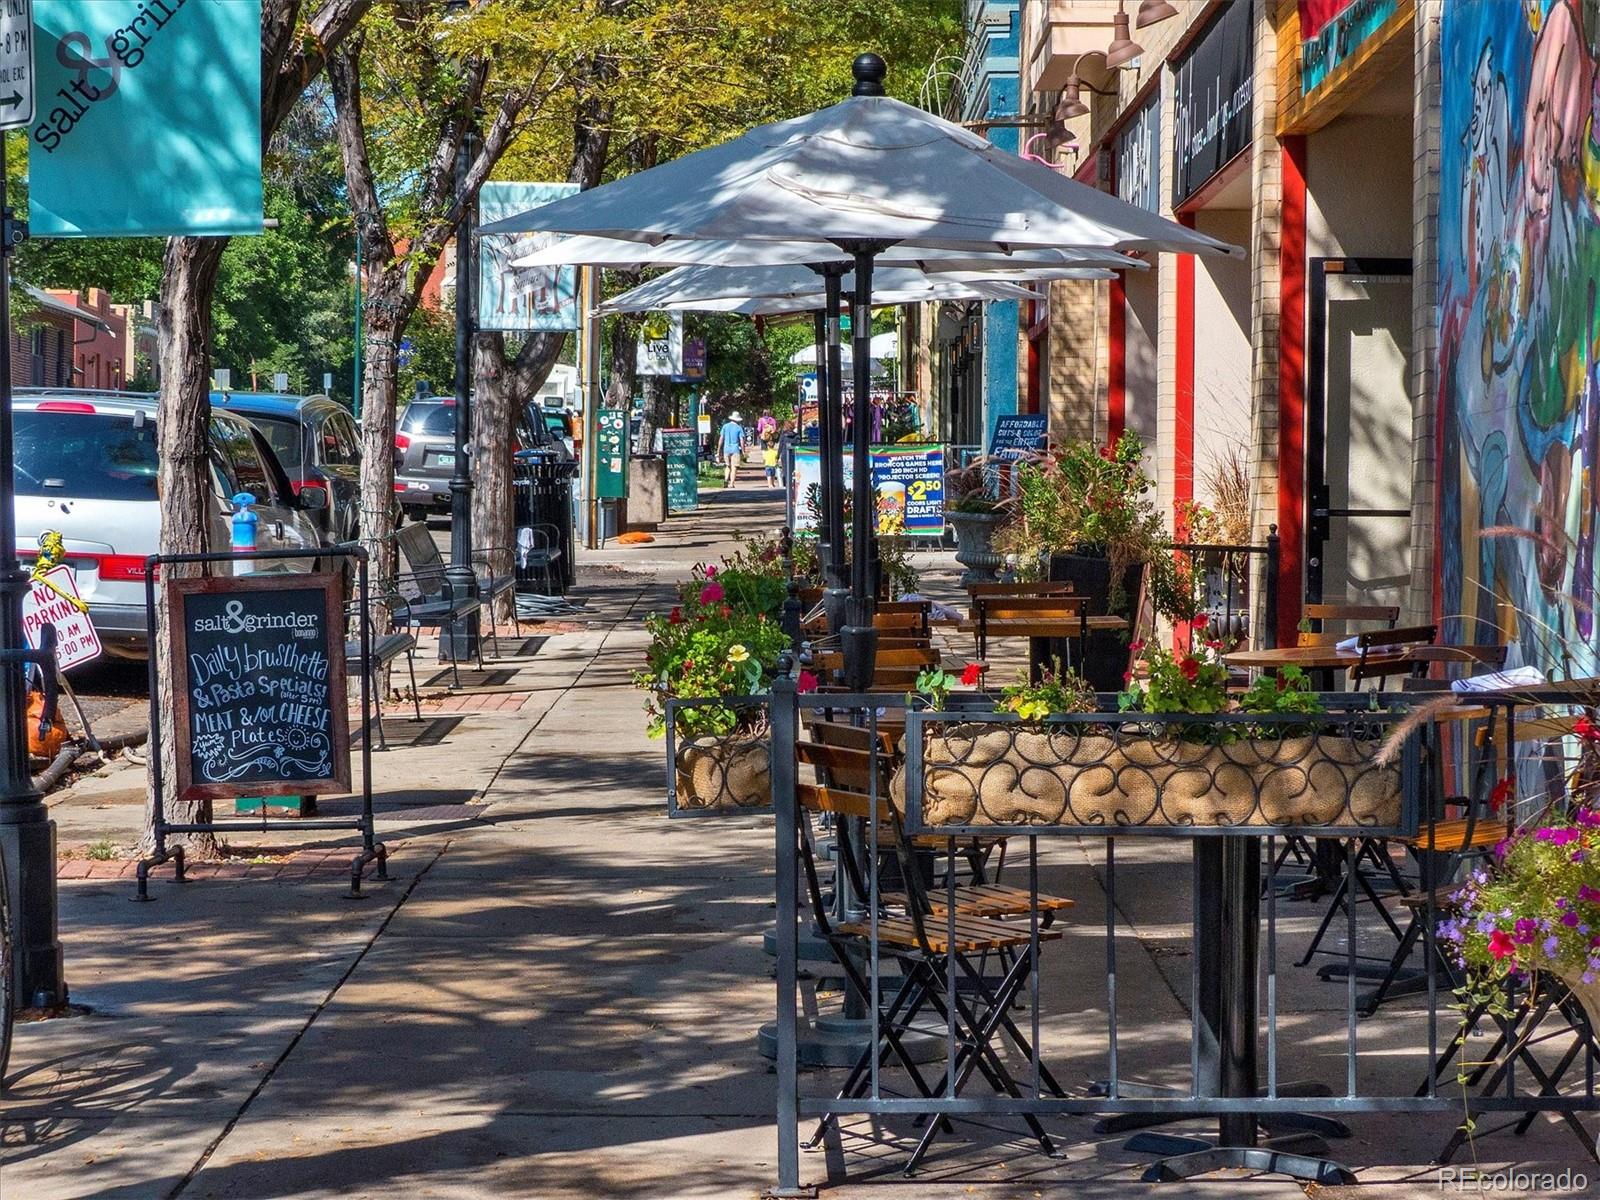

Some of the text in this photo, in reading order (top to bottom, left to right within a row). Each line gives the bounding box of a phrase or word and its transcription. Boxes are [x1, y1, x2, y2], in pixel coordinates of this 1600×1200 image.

[14, 30, 27, 52] PM
[13, 66, 25, 81] EXC
[647, 344, 670, 353] Live
[1000, 420, 1046, 428] AFFORDABLE
[890, 455, 914, 463] WATCH
[907, 505, 943, 515] DRAFTS
[33, 583, 57, 607] NO
[67, 622, 81, 638] AM
[79, 633, 95, 649] PM
[190, 643, 242, 687] Daily
[193, 687, 214, 709] &
[194, 709, 233, 734] MEAT
[279, 702, 332, 732] CHEESE
